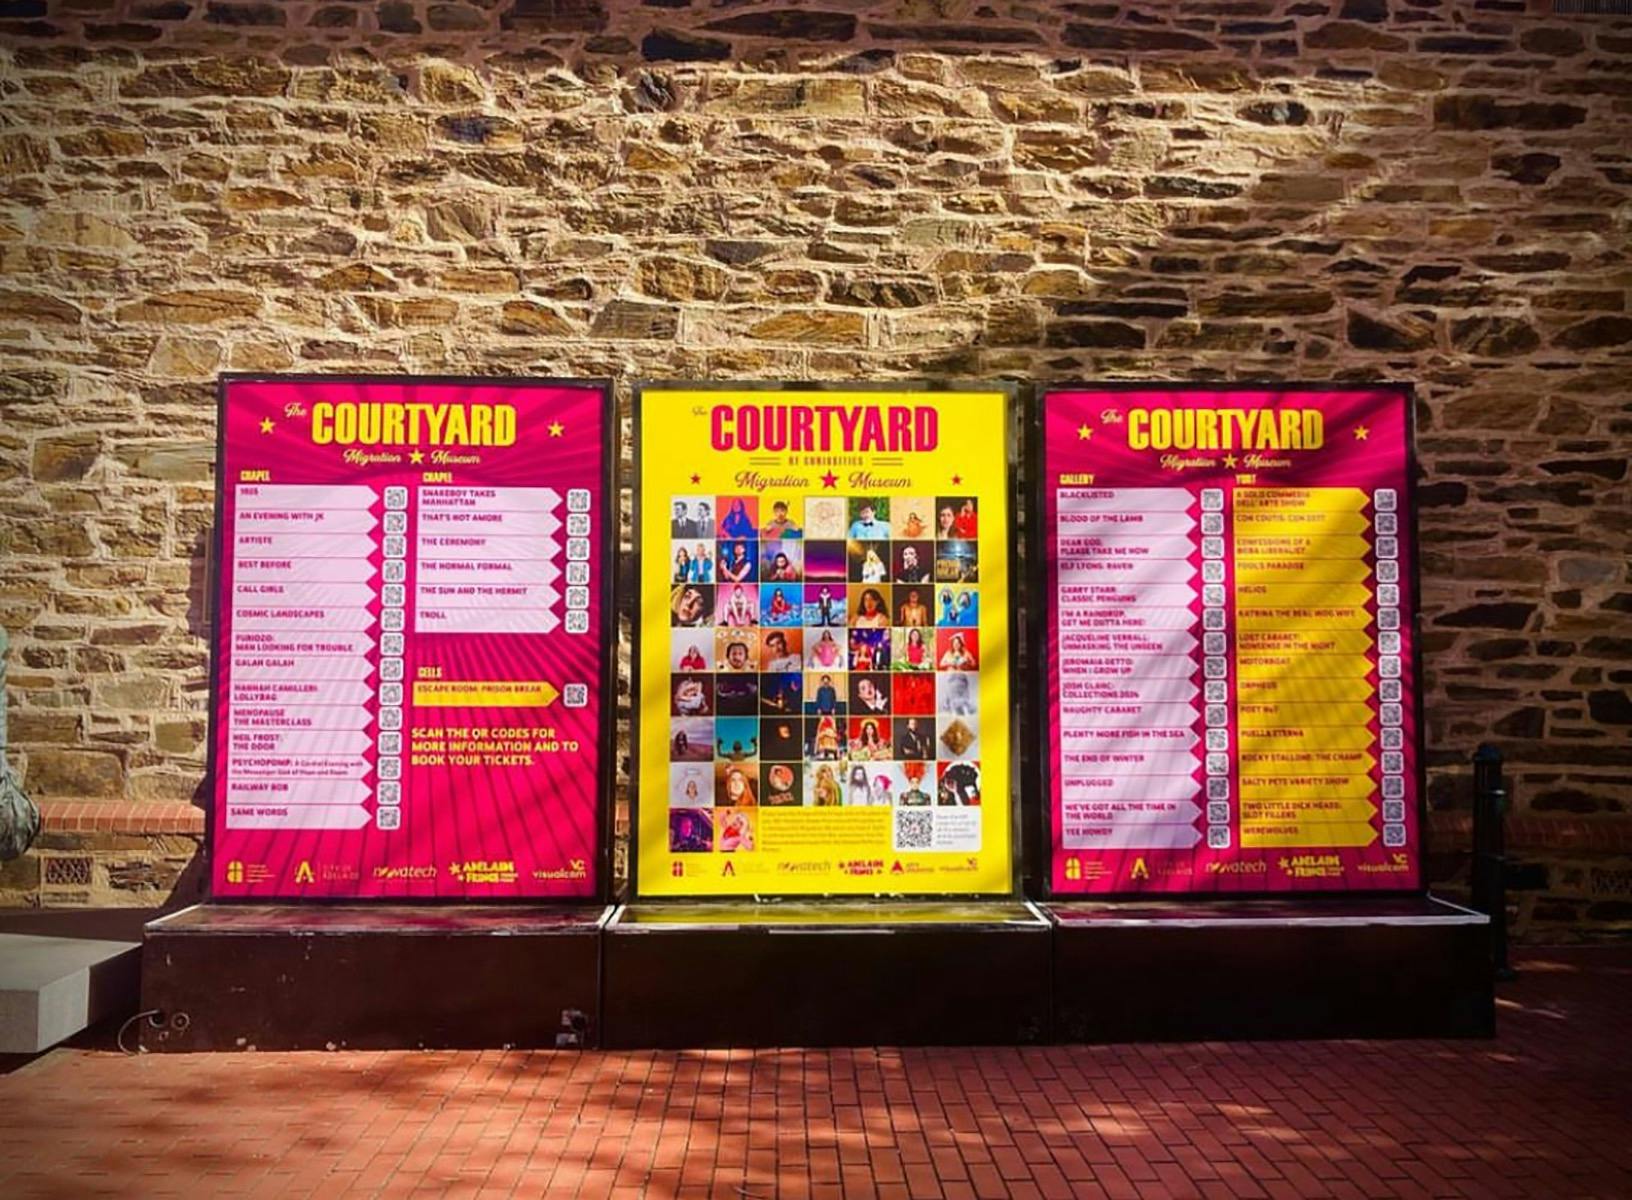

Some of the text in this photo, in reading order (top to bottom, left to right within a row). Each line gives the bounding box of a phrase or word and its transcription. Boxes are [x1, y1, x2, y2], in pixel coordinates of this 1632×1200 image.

[284, 402, 517, 446] The COURTYARD
[711, 404, 938, 452] COURTYARD
[1100, 408, 1324, 450] The COURTYARD
[343, 449, 481, 466] Migration Museum
[1160, 454, 1291, 471] Migration Museum
[422, 472, 453, 483] CHAPEL
[734, 471, 912, 491] Migration Museum
[254, 512, 289, 520] EVENING
[291, 512, 313, 520] WITH
[421, 563, 436, 571] THE
[237, 585, 258, 593] CALL
[420, 587, 436, 595] THE
[438, 587, 455, 595] SUN
[457, 587, 475, 595] AND
[478, 587, 493, 595] THE
[236, 610, 325, 618] COSMIC LANDSCAPES
[257, 644, 295, 652] LOOKING
[297, 644, 313, 652] FOR
[233, 718, 249, 726] THE
[411, 728, 555, 738] SCAN THE QR CODES FOR
[1063, 730, 1094, 738] PLENTY
[1096, 730, 1119, 738] MORE
[1152, 730, 1166, 738] THE
[412, 741, 579, 752] MORE INFORMATION AND TO
[411, 755, 534, 766] BOOK YOUR TICKETS.
[1127, 803, 1143, 811] THE
[231, 808, 288, 816] SAME WORDS
[1066, 812, 1081, 820] THE
